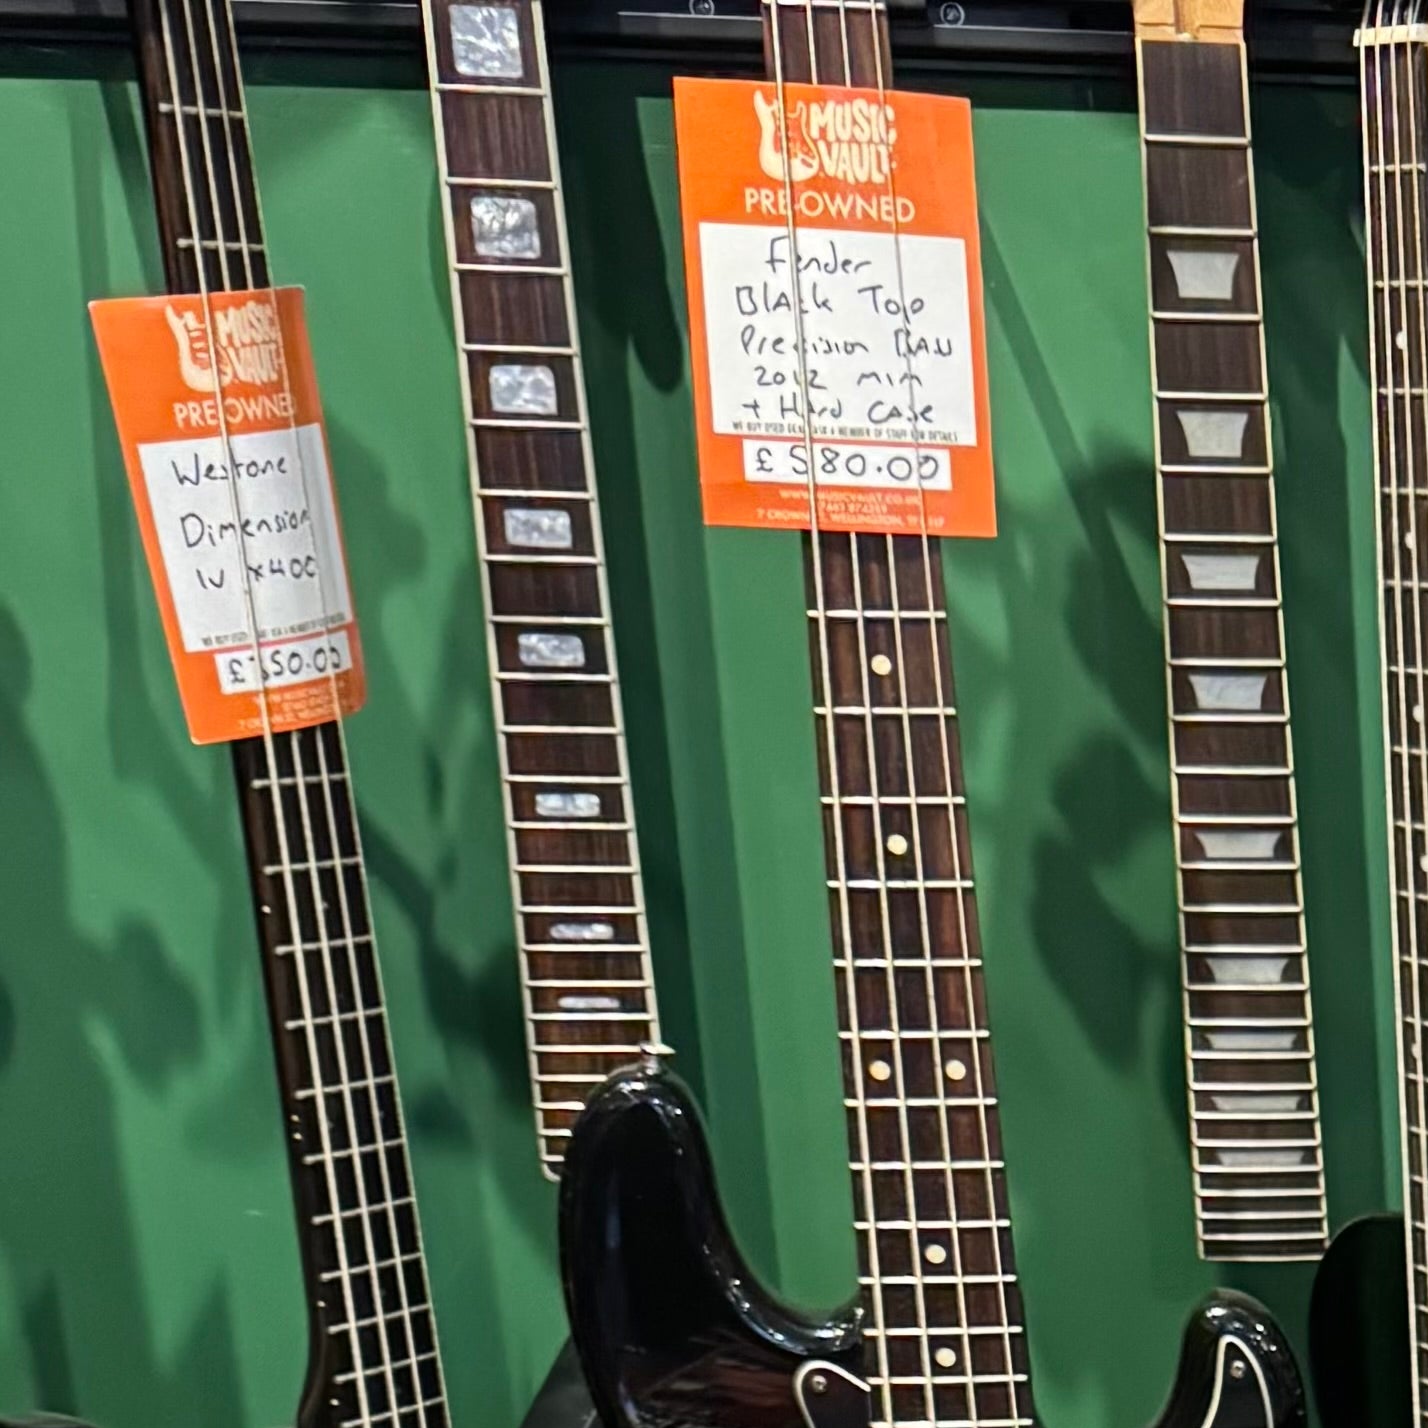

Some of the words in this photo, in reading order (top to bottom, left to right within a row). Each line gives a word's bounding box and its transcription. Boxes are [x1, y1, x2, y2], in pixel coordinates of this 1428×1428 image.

[810, 99, 896, 144] MUSIC
[822, 141, 892, 184] VAULT
[219, 301, 279, 343] MUSIC
[232, 342, 284, 387] VAULT
[173, 393, 295, 429] PREOWNED
